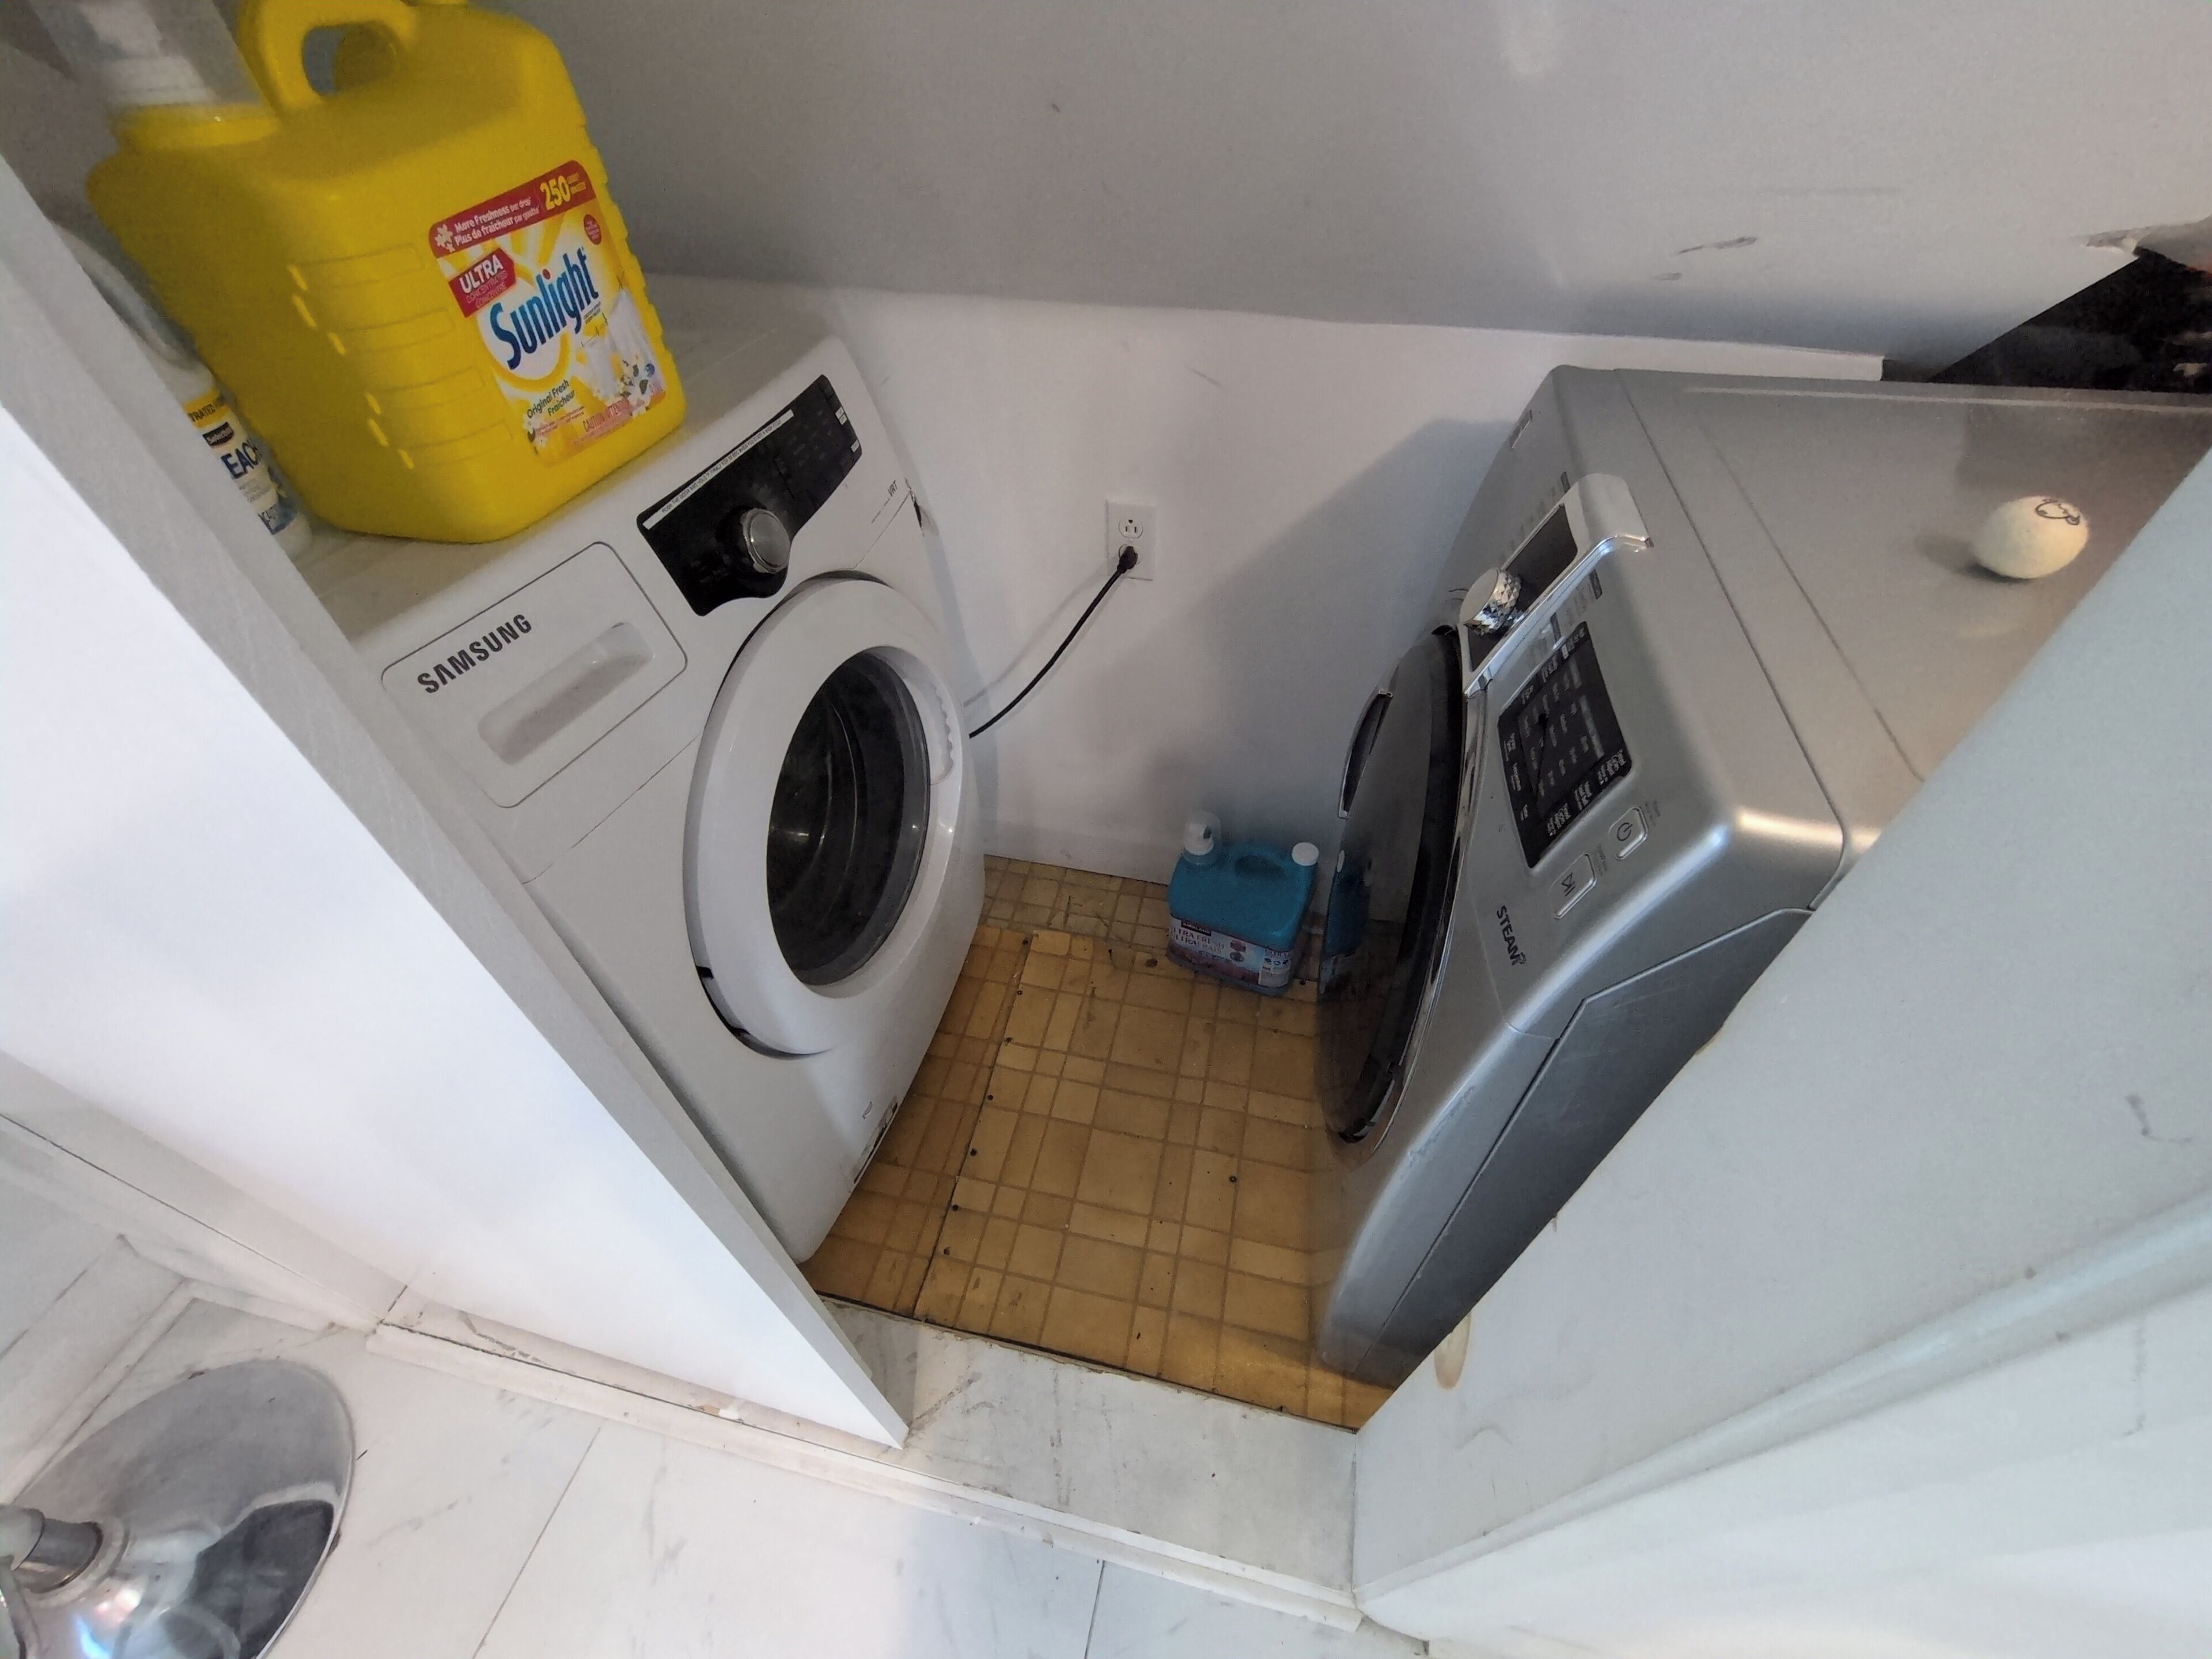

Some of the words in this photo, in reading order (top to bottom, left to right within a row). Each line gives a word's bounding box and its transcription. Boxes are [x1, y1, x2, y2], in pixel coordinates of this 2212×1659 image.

[539, 175, 572, 211] 250
[454, 219, 475, 233] More
[474, 205, 510, 225] Freshness
[454, 233, 472, 246] Plus
[472, 229, 482, 239] de
[459, 253, 504, 294] ULTRA
[490, 246, 599, 370] Sunlight
[527, 391, 553, 419] Original
[552, 379, 570, 399] Fresh
[888, 480, 899, 498] VRT
[417, 614, 532, 694] SAMSUNG
[1497, 905, 1521, 966] STEAM
